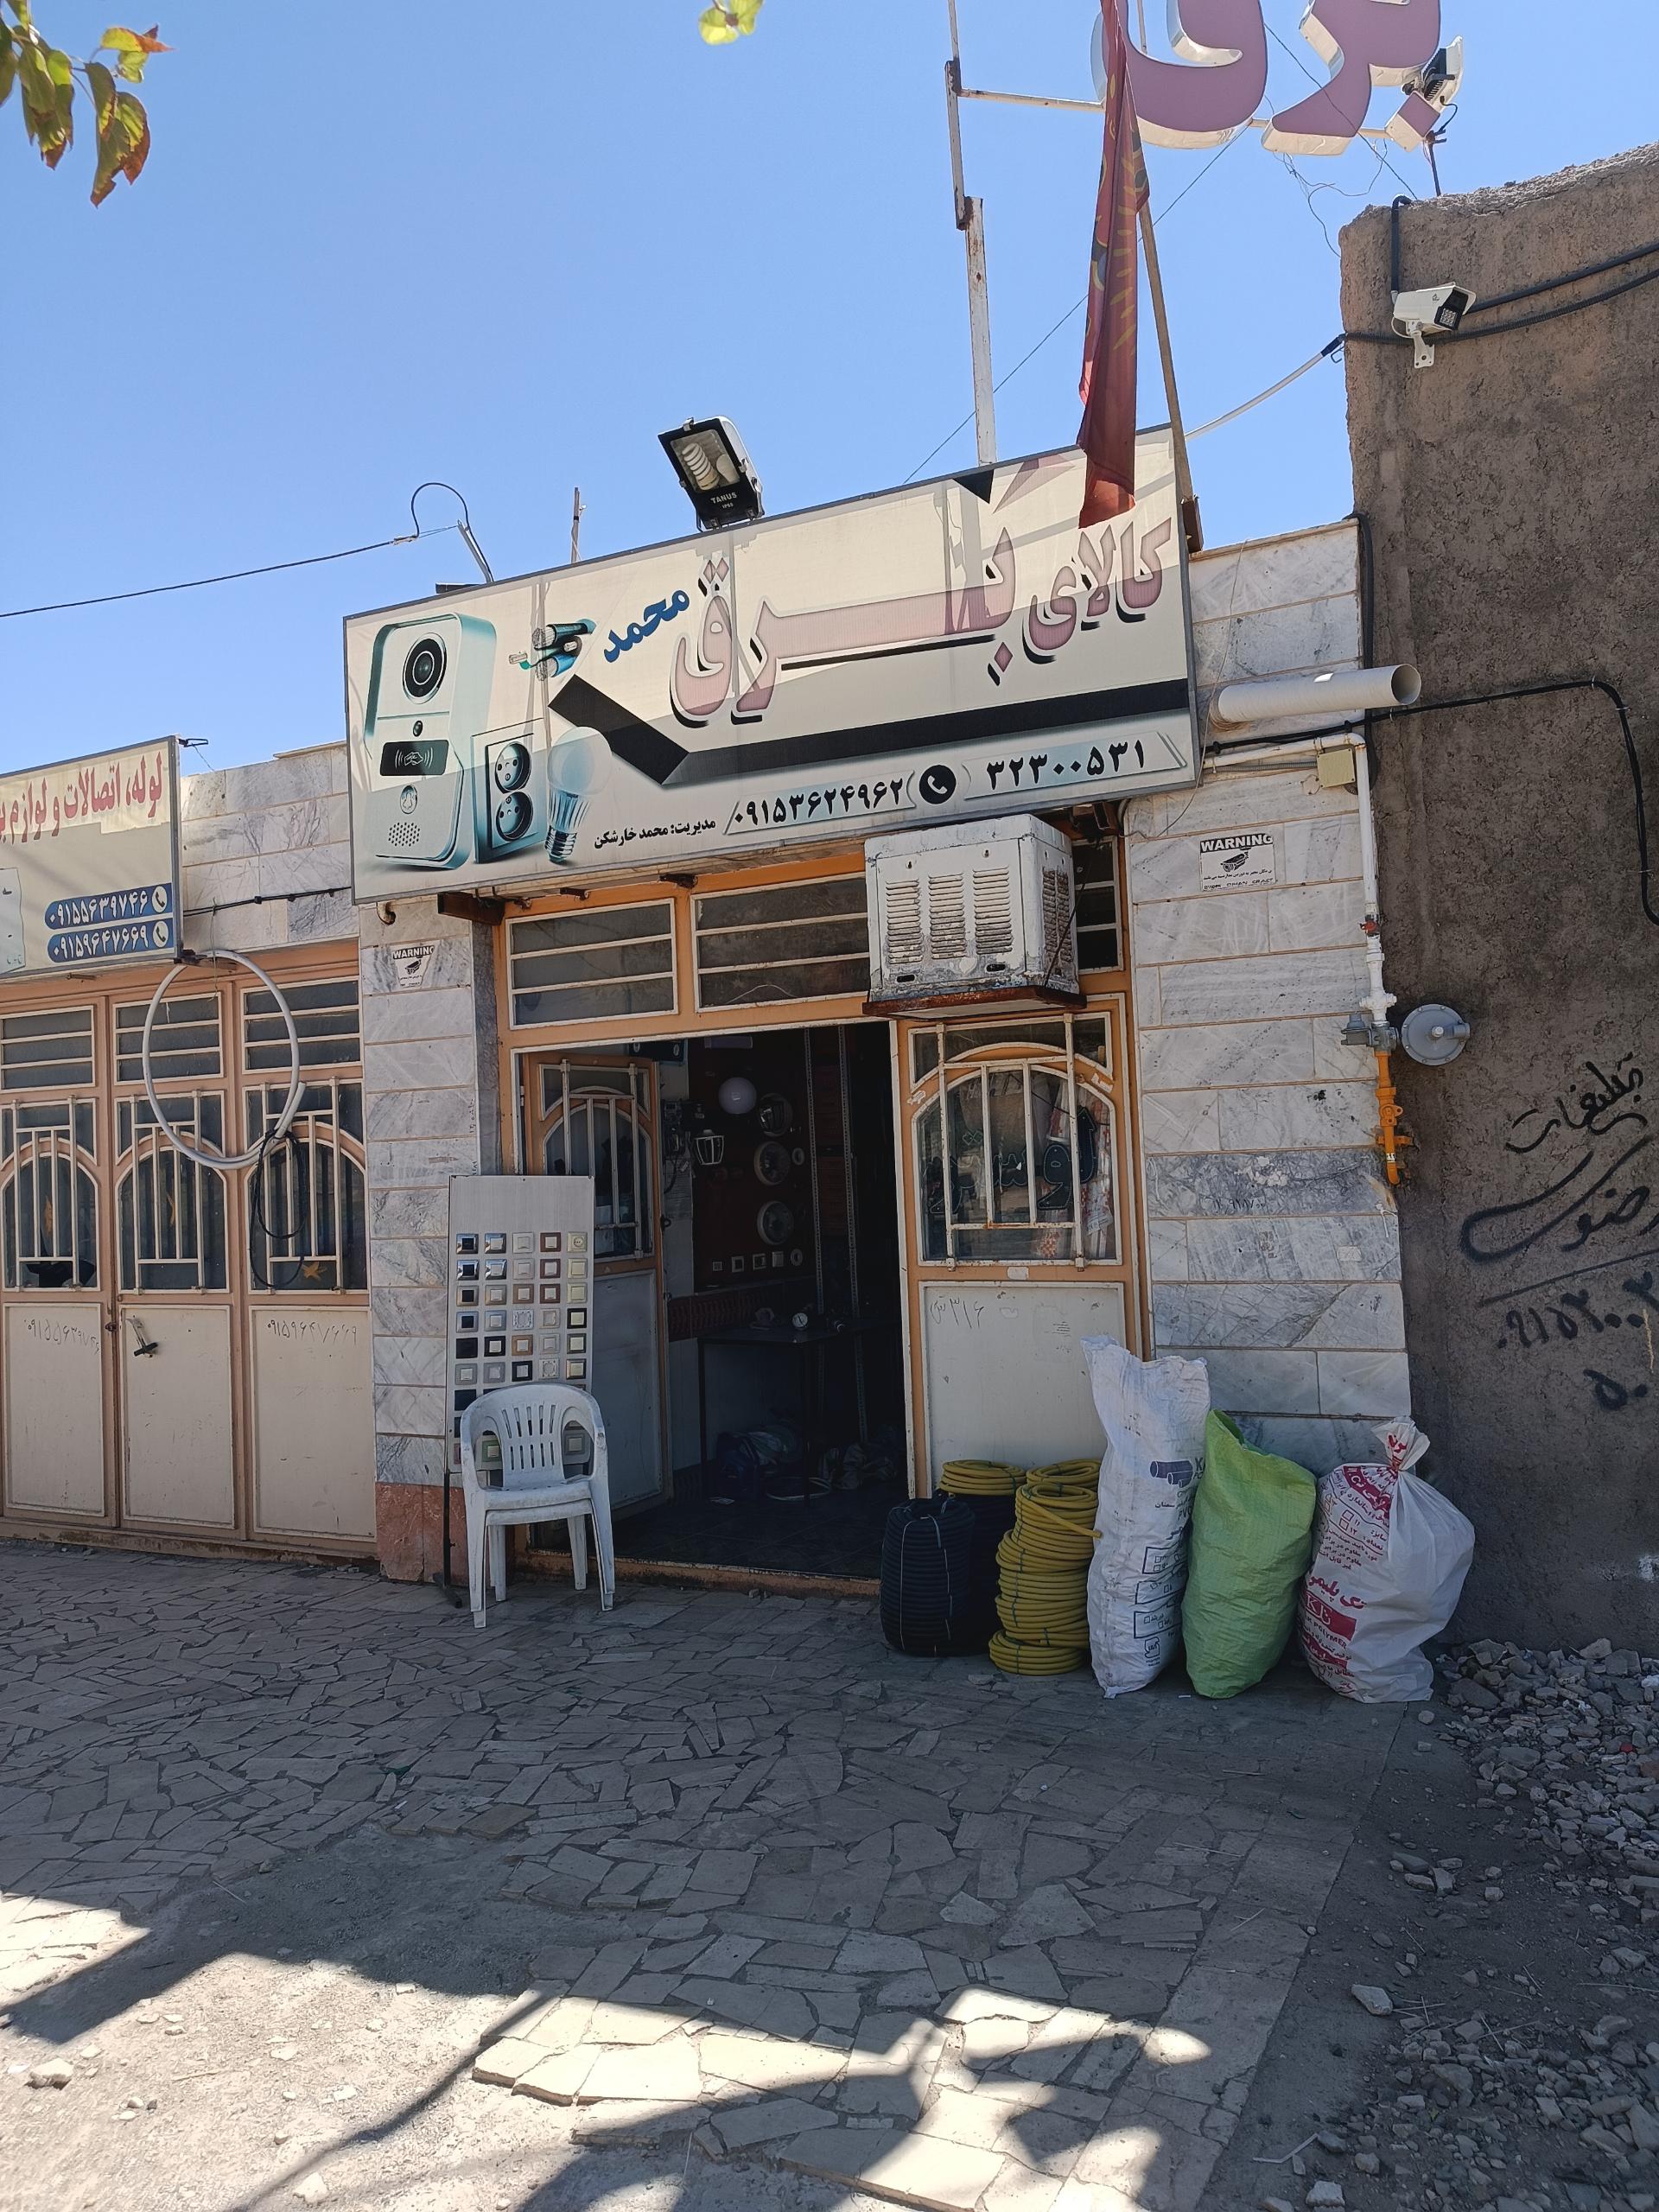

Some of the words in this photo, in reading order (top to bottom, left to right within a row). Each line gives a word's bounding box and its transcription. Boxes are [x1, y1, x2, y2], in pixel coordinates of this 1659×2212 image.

[709, 492, 737, 504] TANUS
[1027, 518, 1173, 654] کالای
[604, 588, 690, 662] محمد
[671, 524, 1019, 719] برق
[986, 738, 1147, 791] ۳۲۳۰۰۵۳۱
[63, 761, 121, 819] اتصالات
[733, 786, 905, 825] ۰۹۱۵۳۶۲۴۹۶۲
[10, 778, 48, 845] لوازم
[51, 796, 60, 837] و
[639, 825, 669, 839] محمد
[1200, 833, 1274, 853] WARNING
[49, 890, 148, 926] ۰۹۱۵۵۶۳۹۷۴۶
[54, 925, 149, 958] ۰۹۱۵۹۶۴۷۶۶۹
[1313, 1621, 1348, 1649] POLYMER
